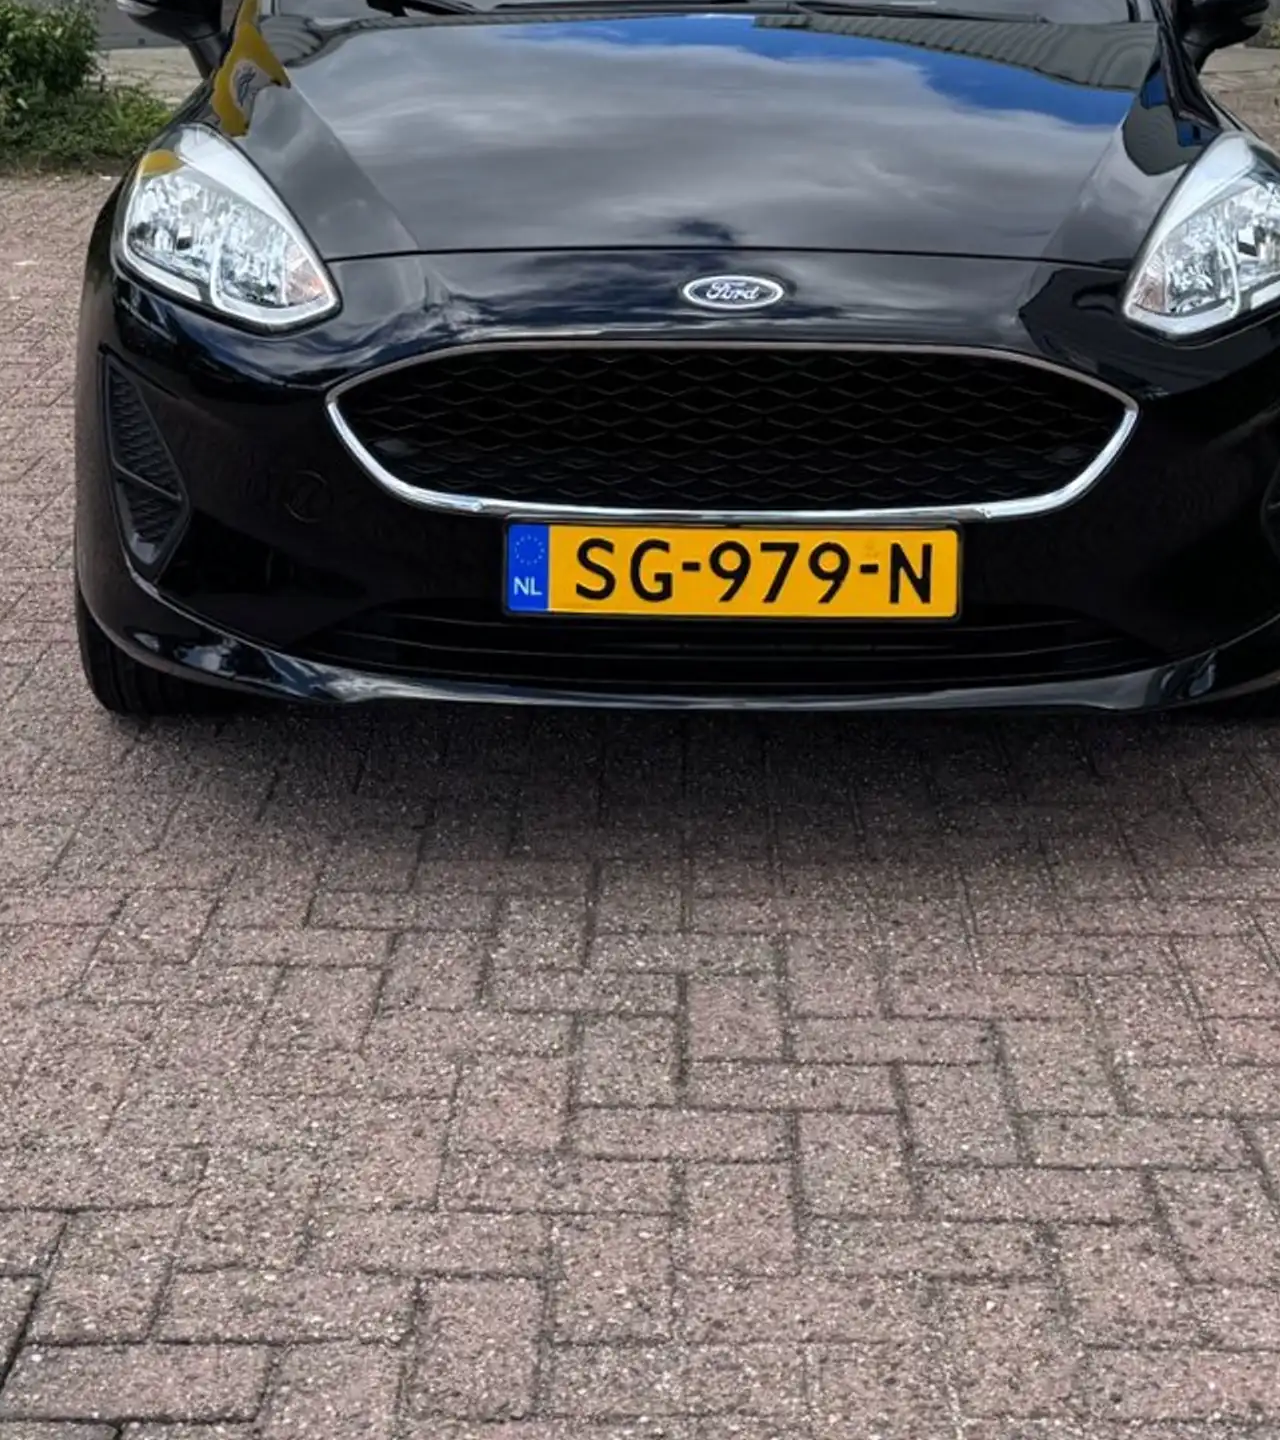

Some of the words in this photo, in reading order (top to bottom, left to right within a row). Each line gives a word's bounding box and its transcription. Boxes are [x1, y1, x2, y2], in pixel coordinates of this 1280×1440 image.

[705, 281, 761, 300] Ford
[574, 537, 933, 605] SG-979-N
[513, 575, 543, 596] NL
